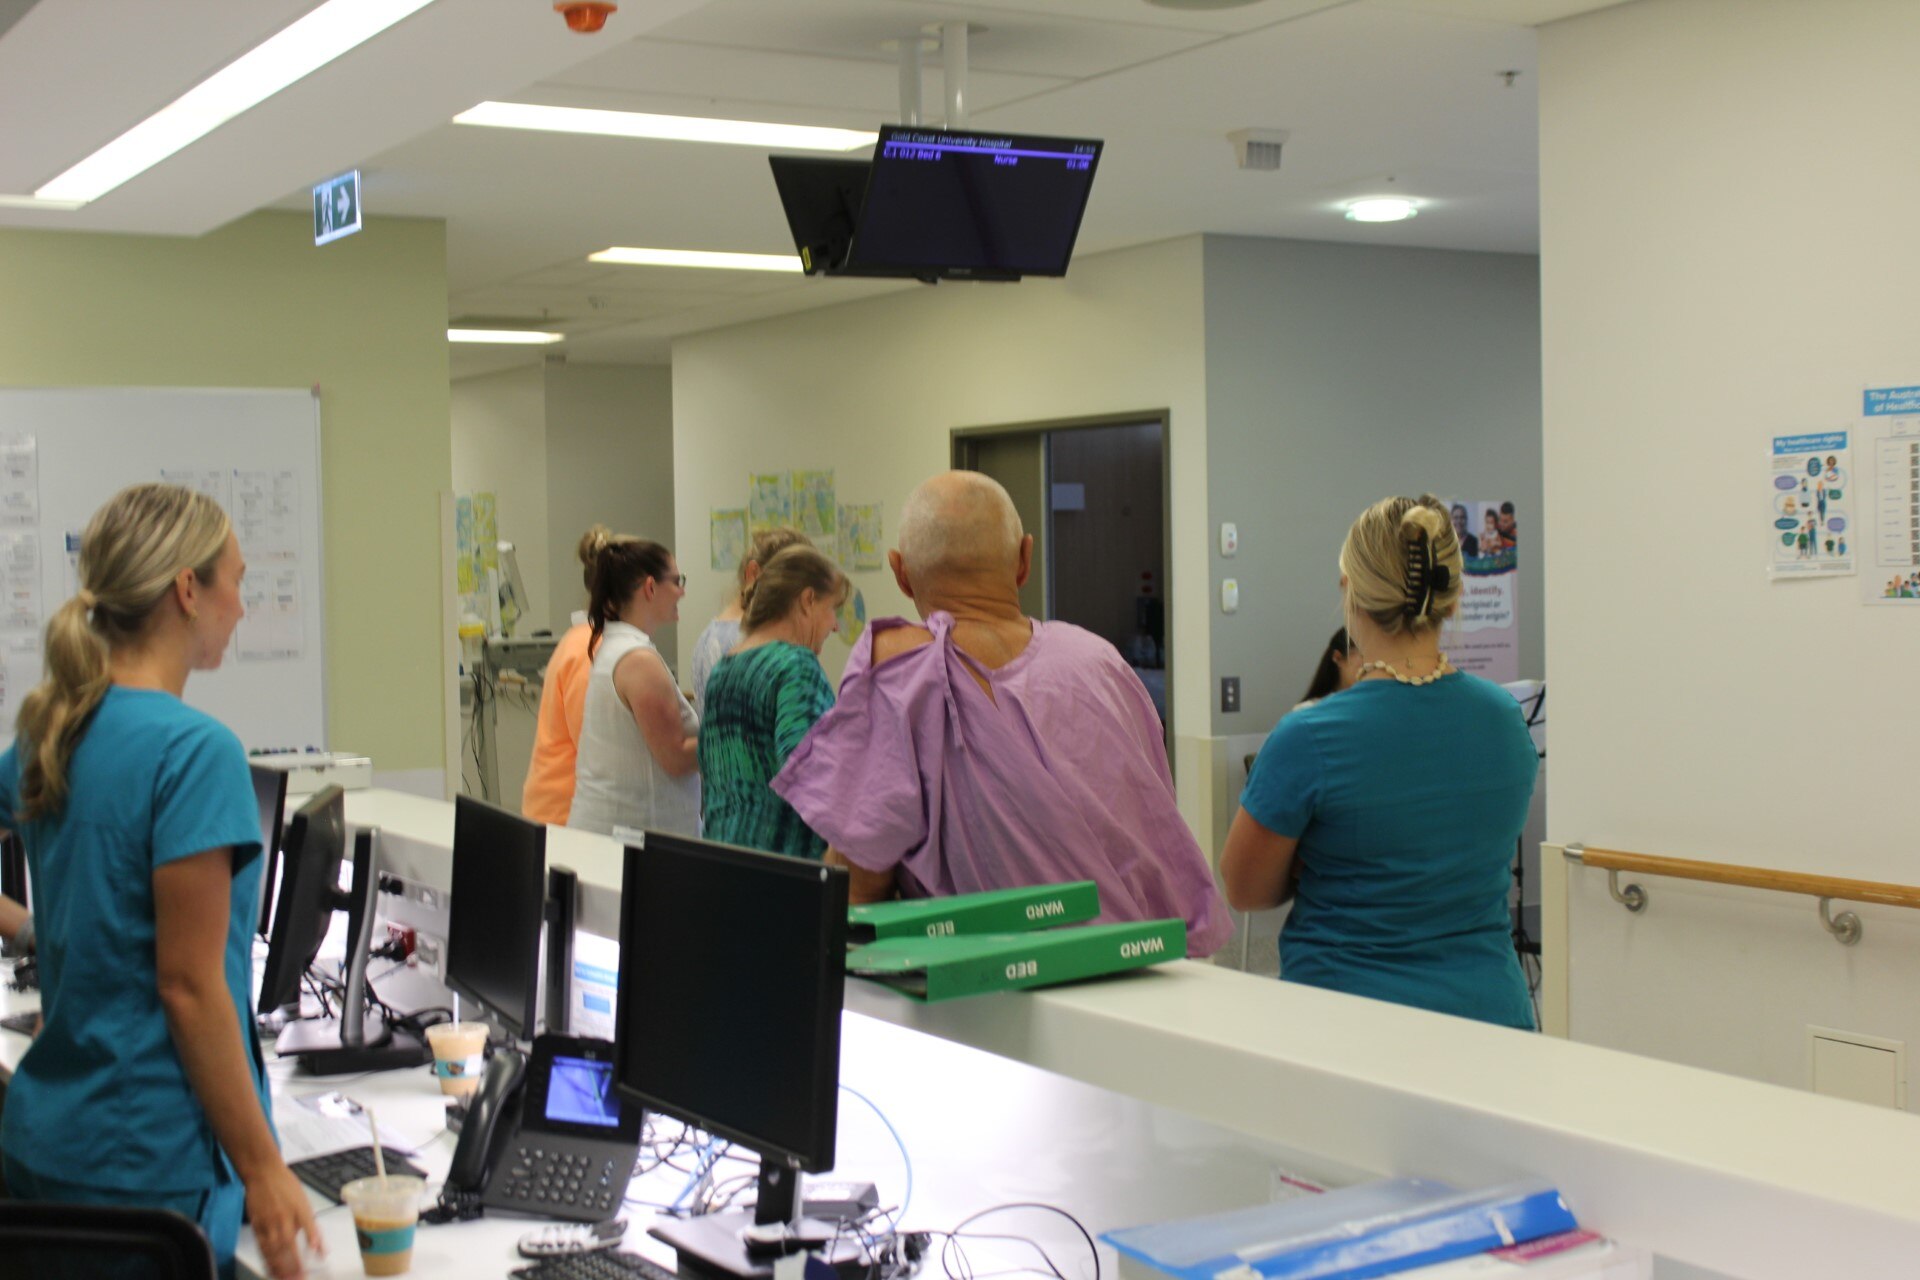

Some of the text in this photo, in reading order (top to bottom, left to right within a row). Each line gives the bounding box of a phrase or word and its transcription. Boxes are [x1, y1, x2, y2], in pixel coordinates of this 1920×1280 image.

[891, 132, 1012, 150] Gold Coast University Hospital
[994, 155, 1018, 166] Nurse
[1026, 900, 1064, 920] WARD
[926, 920, 955, 938] BED
[1120, 936, 1164, 958] WARD
[1005, 960, 1038, 980] BED
